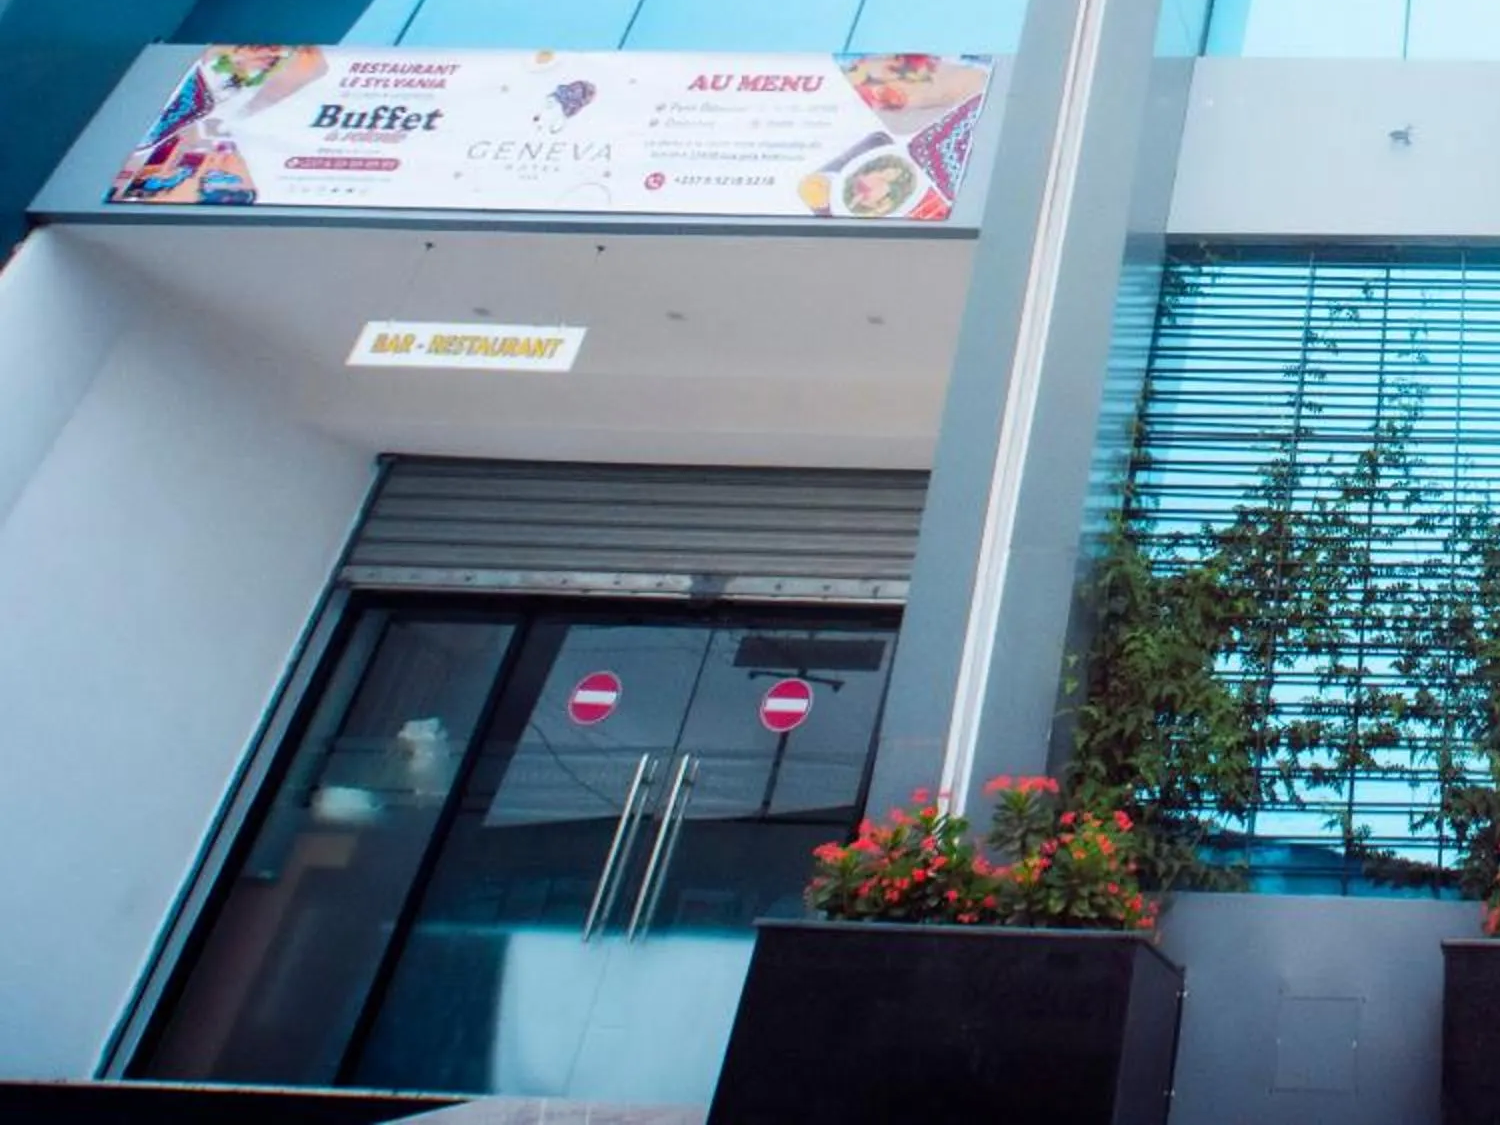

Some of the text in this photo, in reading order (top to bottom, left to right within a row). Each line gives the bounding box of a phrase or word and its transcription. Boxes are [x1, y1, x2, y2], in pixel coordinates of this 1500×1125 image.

[349, 61, 460, 76] RESTAURANT
[339, 76, 357, 88] LE
[687, 74, 824, 92] AU MENU
[309, 103, 444, 131] Buffet
[466, 141, 612, 161] GENEVA
[370, 333, 415, 354] BAR
[425, 334, 564, 359] RESTAURANT
